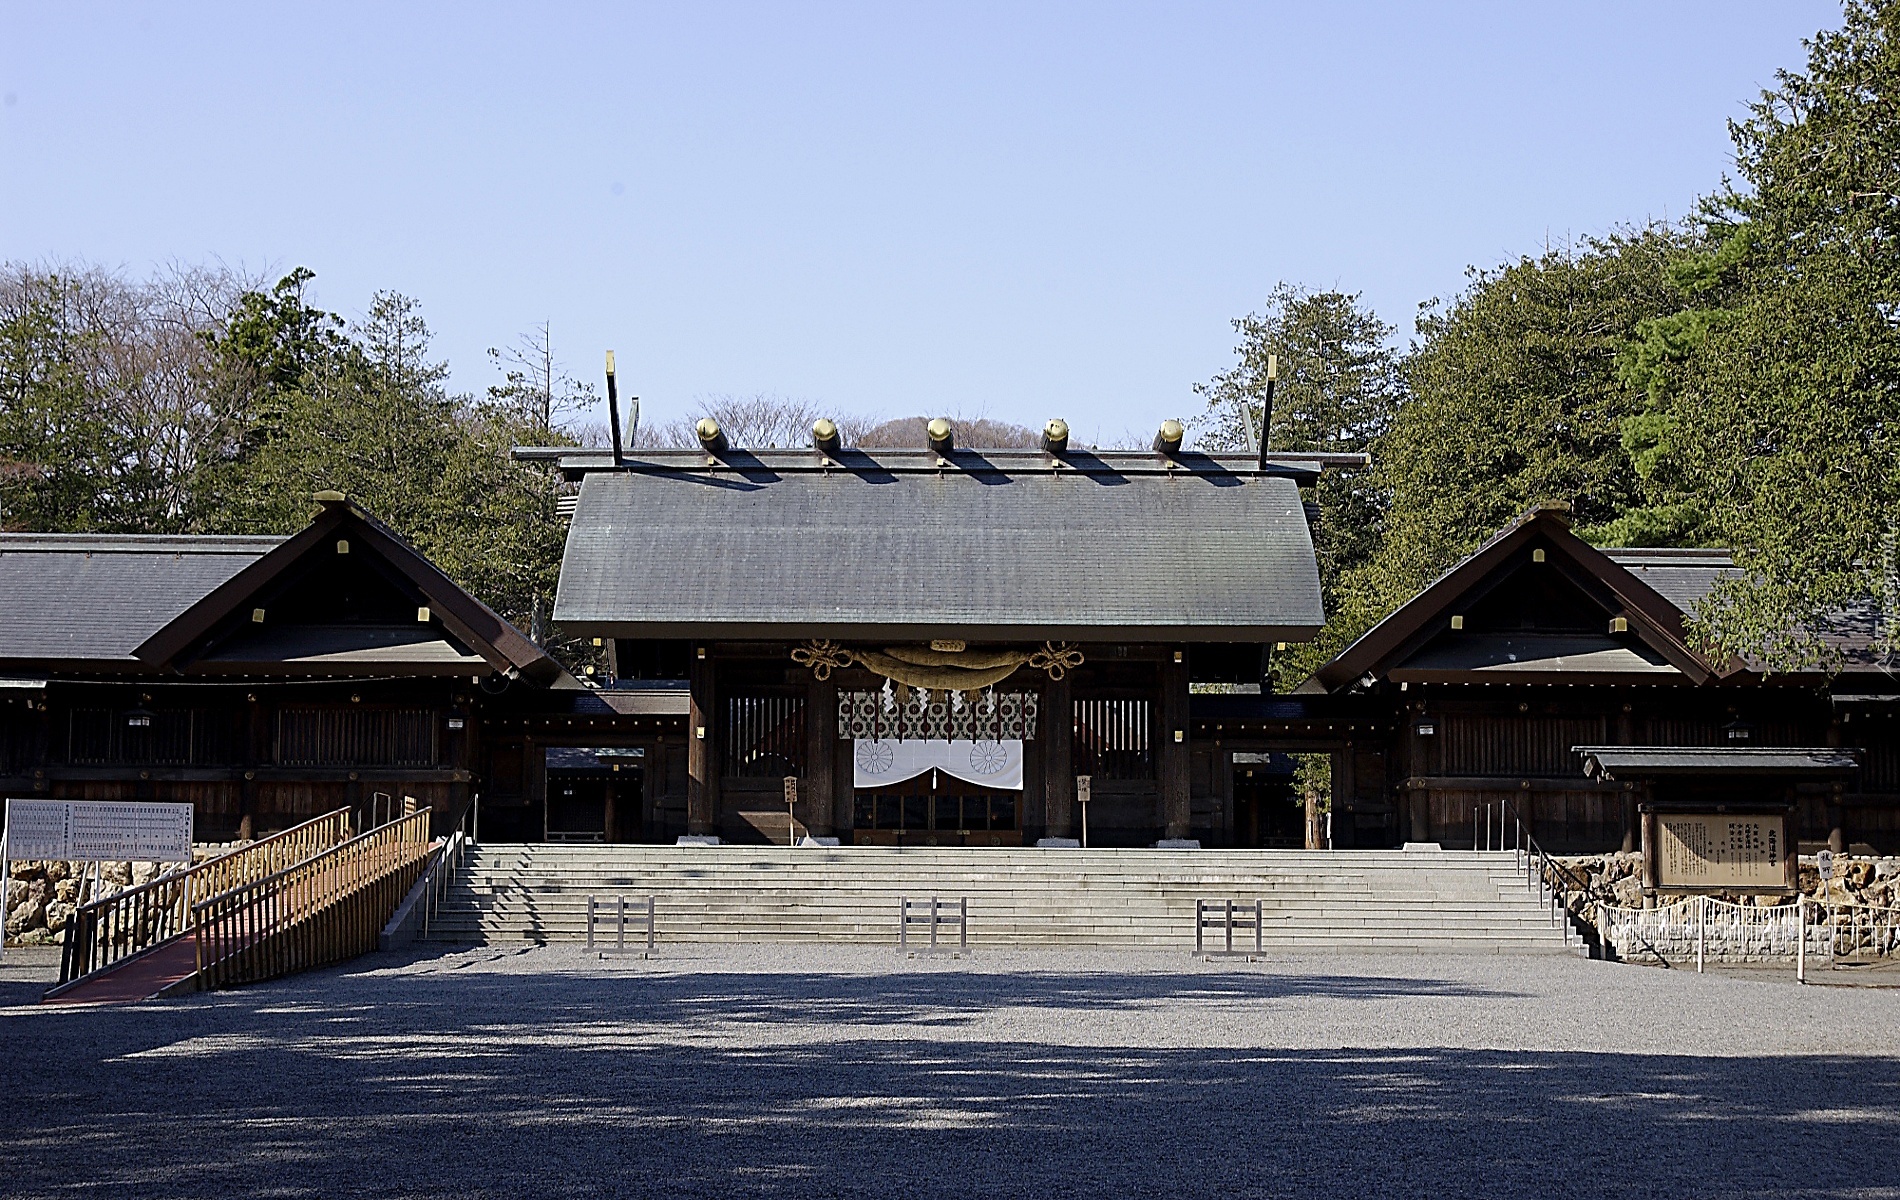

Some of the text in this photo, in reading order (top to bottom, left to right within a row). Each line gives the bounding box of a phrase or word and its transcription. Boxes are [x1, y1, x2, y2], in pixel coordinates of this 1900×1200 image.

[1769, 829, 1777, 867] 北海道神宮
